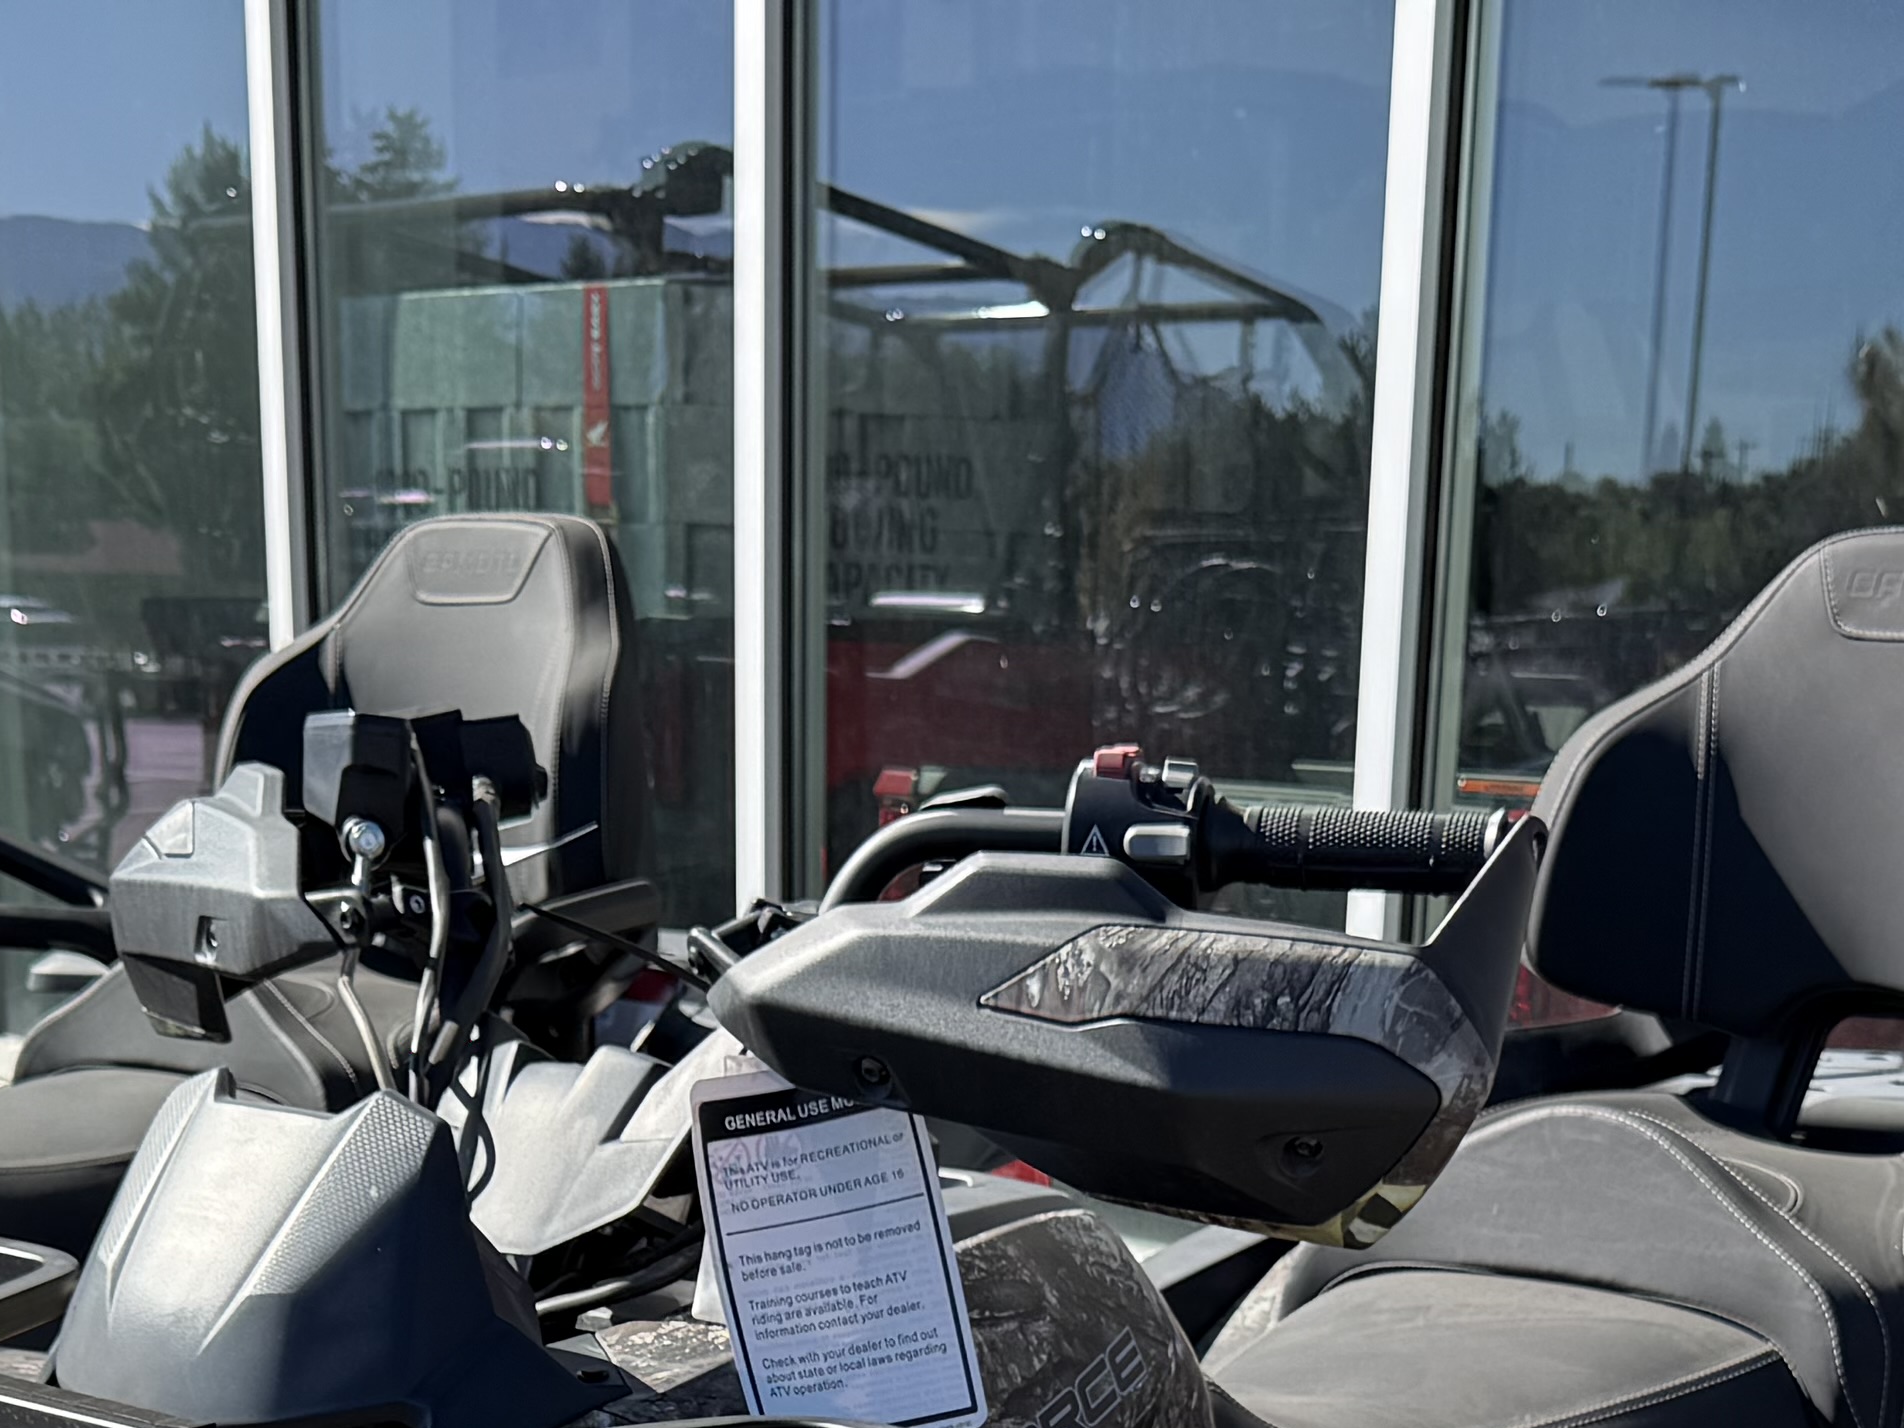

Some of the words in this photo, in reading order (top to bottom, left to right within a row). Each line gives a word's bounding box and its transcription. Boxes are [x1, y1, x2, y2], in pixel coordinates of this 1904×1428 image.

[724, 1107, 796, 1131] GENERAL
[797, 1098, 829, 1119] USE
[747, 1161, 769, 1175] ATV
[771, 1159, 782, 1170] is
[782, 1155, 798, 1168] for
[800, 1136, 892, 1164] RECREATIONAL
[892, 1132, 904, 1143] or
[724, 1172, 769, 1191] UTILITY
[771, 1169, 801, 1184] USE.
[730, 1200, 750, 1215] NO
[751, 1187, 818, 1211] OPERATOR
[820, 1177, 863, 1197] UNDER
[863, 1171, 888, 1187] AGE
[892, 1168, 905, 1181] 16
[739, 1254, 763, 1267] This
[763, 1247, 793, 1264] hang
[793, 1245, 812, 1259] tag
[813, 1241, 824, 1253] is
[825, 1237, 843, 1251] not
[844, 1236, 856, 1248] to
[857, 1232, 872, 1244] be
[873, 1220, 921, 1241] removed
[741, 1265, 778, 1282] before
[779, 1260, 807, 1275] sale.
[748, 1294, 793, 1312] Training
[794, 1287, 838, 1304] courses
[839, 1284, 852, 1295] to
[852, 1275, 884, 1292] teach
[884, 1270, 908, 1286] ATV
[751, 1311, 783, 1327] riding
[784, 1309, 803, 1321] are
[804, 1299, 859, 1317] available.
[859, 1293, 878, 1307] For
[754, 1321, 817, 1341] information
[818, 1313, 859, 1331] contact
[860, 1309, 884, 1325] your
[886, 1300, 925, 1317] dealer.
[762, 1354, 797, 1370] Check
[798, 1350, 820, 1366] with
[822, 1346, 846, 1363] your
[848, 1339, 882, 1357] dealer
[883, 1336, 896, 1348] to
[897, 1331, 918, 1347] find
[919, 1327, 939, 1341] out
[766, 1367, 797, 1384] about
[797, 1363, 825, 1379] state
[826, 1362, 838, 1374] or
[839, 1356, 866, 1373] local
[867, 1353, 894, 1368] laws
[895, 1342, 947, 1363] regarding
[770, 1382, 791, 1398] ATV
[793, 1378, 849, 1398] operation.
